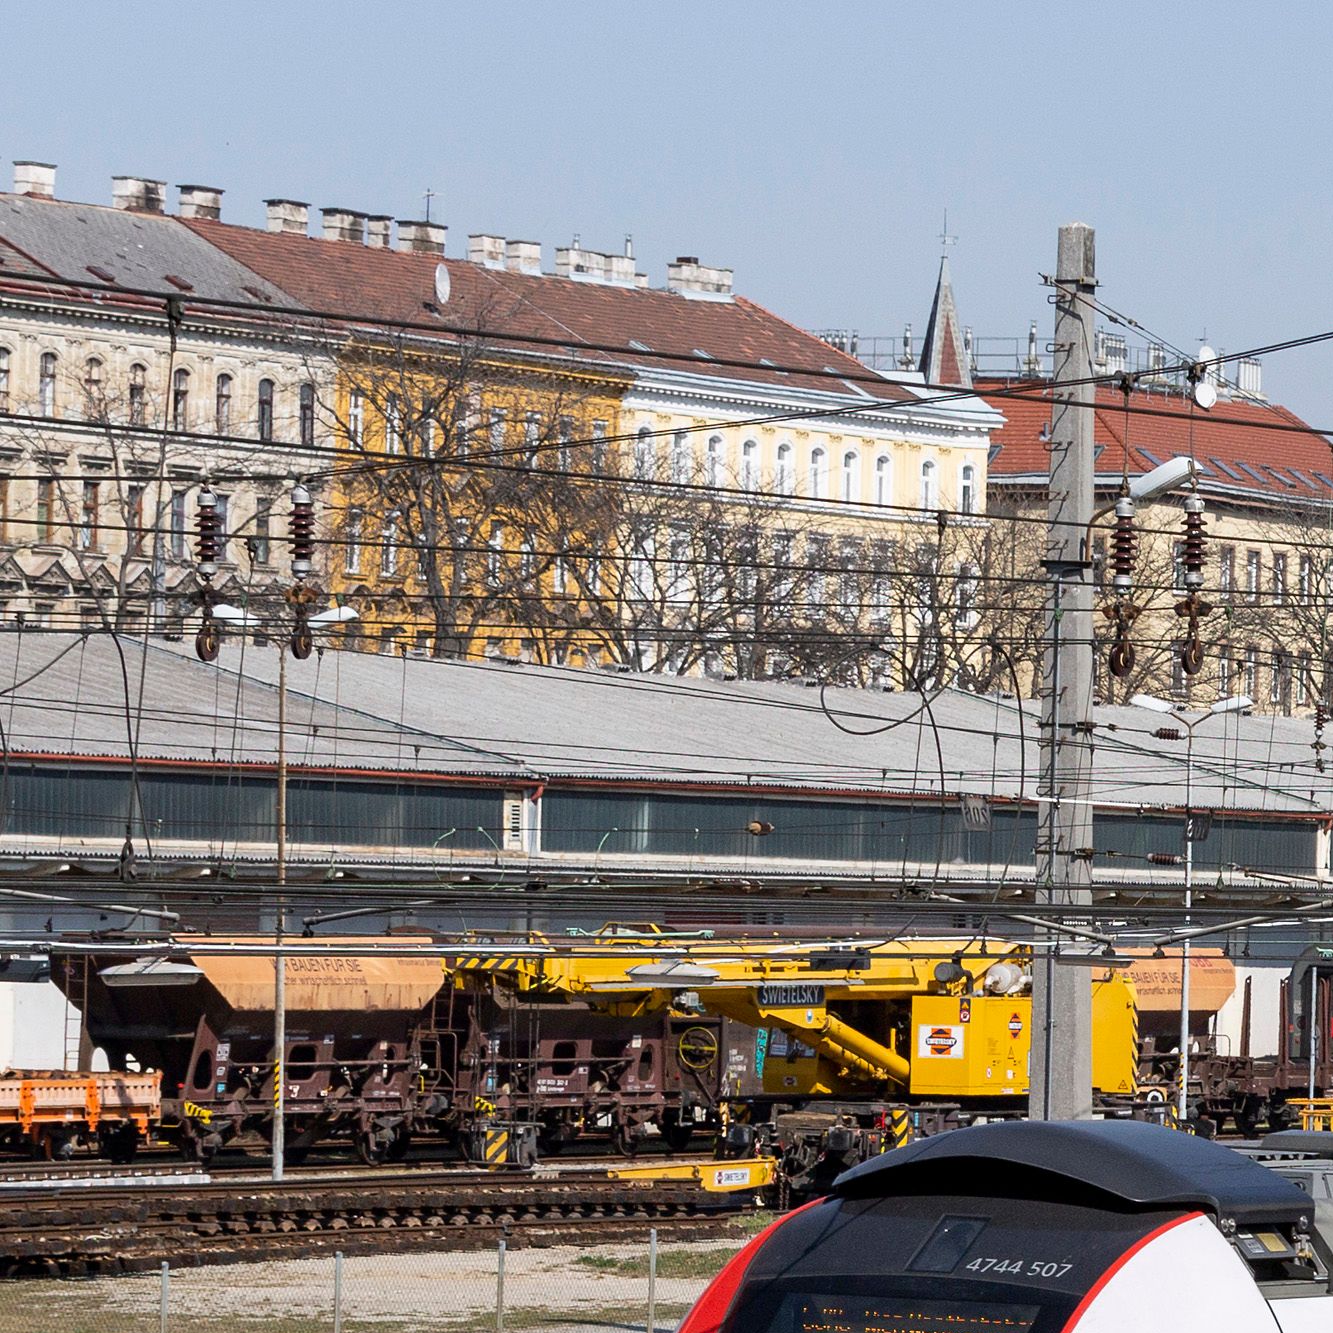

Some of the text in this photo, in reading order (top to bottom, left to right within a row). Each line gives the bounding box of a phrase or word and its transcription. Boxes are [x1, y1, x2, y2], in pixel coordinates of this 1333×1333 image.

[761, 986, 821, 1005] SWIETELSKY
[966, 1258, 1073, 1278] 4744 507
